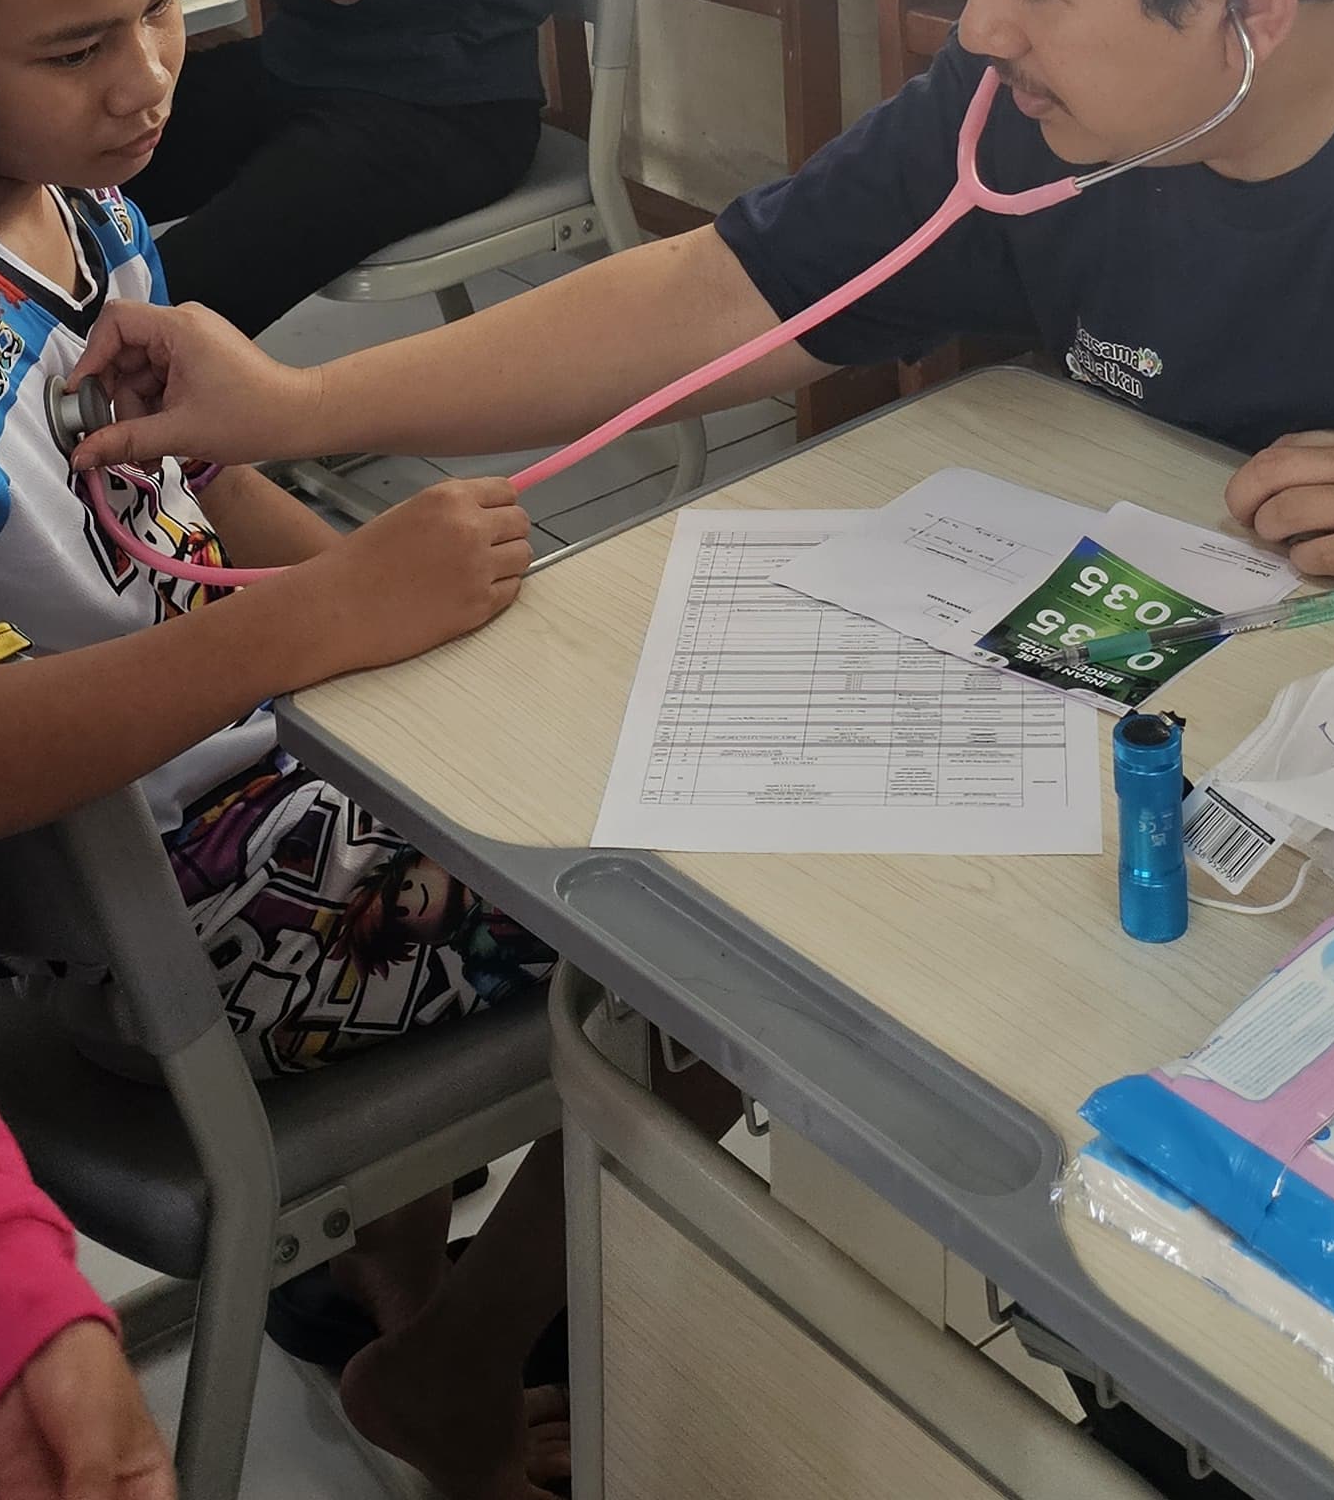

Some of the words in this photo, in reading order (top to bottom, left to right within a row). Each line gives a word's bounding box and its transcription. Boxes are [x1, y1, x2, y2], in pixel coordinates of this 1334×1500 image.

[1070, 566, 1196, 625] 035
[1017, 642, 1052, 662] 2025
[1027, 609, 1164, 671] 035
[1068, 667, 1109, 690] INSAN
